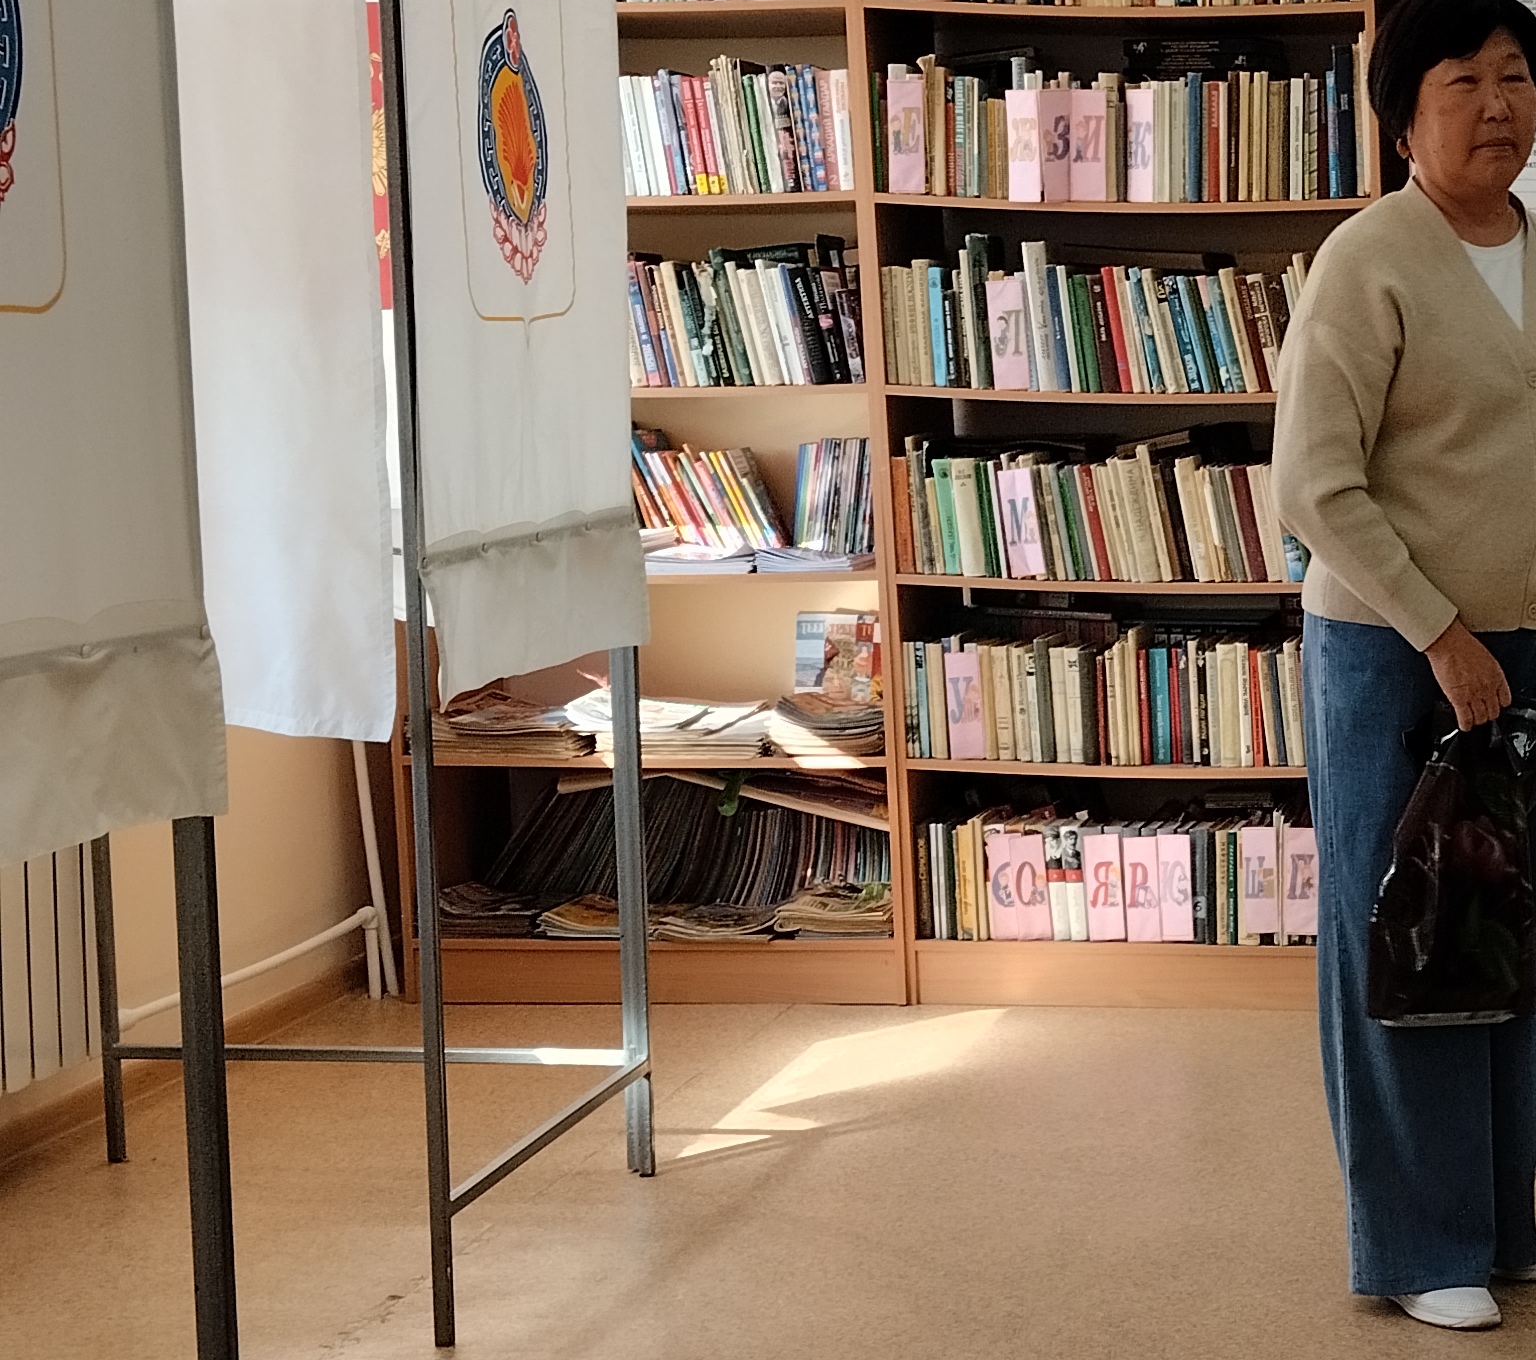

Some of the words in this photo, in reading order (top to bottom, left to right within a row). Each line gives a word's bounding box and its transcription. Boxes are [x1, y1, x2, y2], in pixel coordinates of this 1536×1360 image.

[819, 79, 832, 117] ГАЙДАР
[823, 117, 837, 164] АРКАДИЙ
[1049, 115, 1071, 161] З
[1131, 120, 1152, 170] К
[1126, 468, 1144, 532] НАДЕЖДИНА
[948, 676, 974, 725] У
[1090, 861, 1114, 908] Я
[1127, 862, 1149, 909] Р
